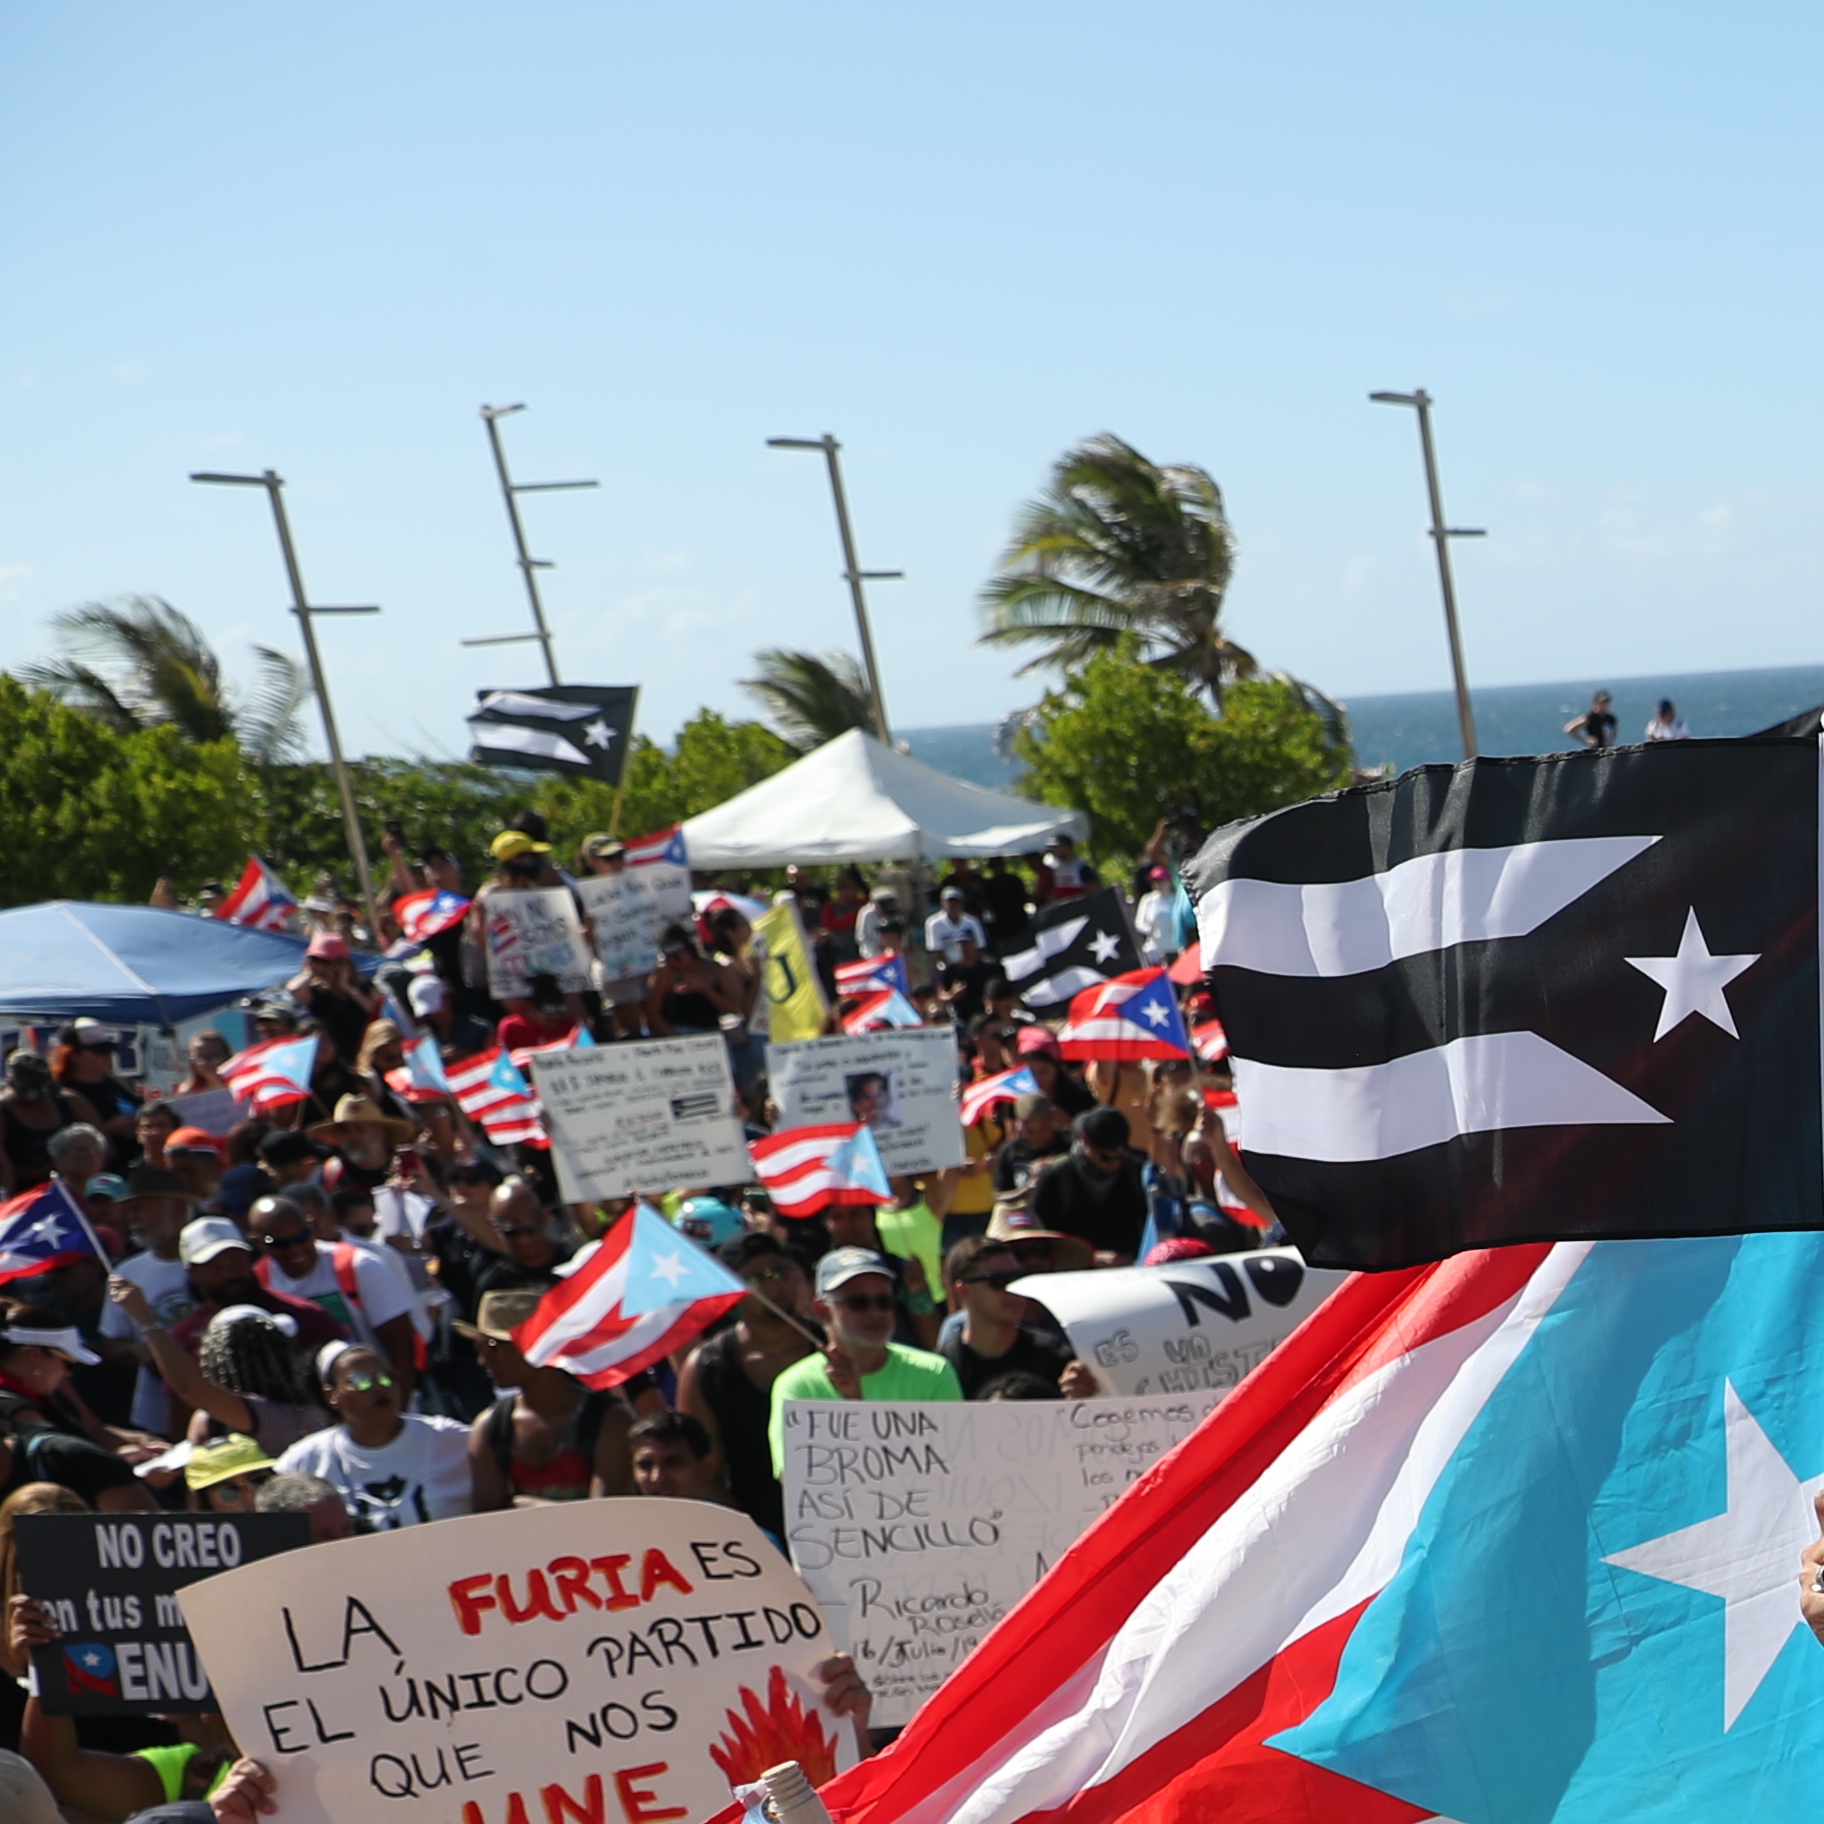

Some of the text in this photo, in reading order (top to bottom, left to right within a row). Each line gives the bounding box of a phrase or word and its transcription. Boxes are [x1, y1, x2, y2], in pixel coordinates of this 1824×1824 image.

[1093, 1329, 1139, 1369] ES
[871, 1410, 940, 1440] UNA
[795, 1442, 951, 1488] BROMA
[873, 1489, 932, 1520] DE
[94, 1522, 242, 1570] NO CREO
[86, 1588, 143, 1632] tus
[282, 1541, 762, 1673] LA FURIA ES
[849, 1576, 990, 1622] Ricardo
[264, 1602, 822, 1755] EL ÚNICO PARTIDO
[370, 1689, 679, 1800] QUE NOS
